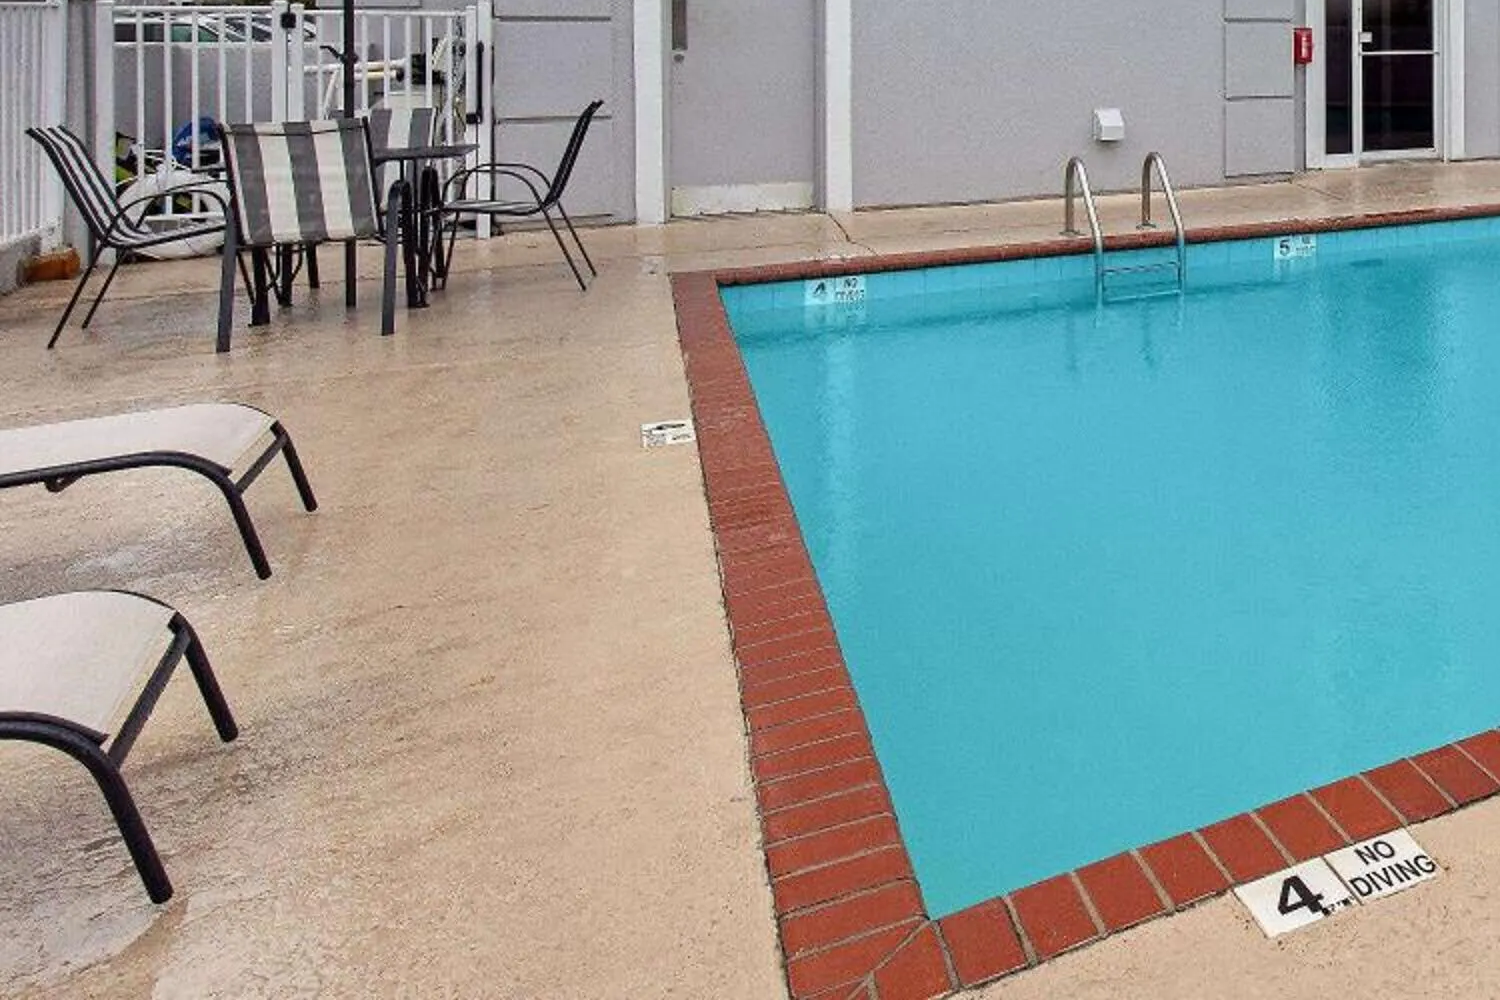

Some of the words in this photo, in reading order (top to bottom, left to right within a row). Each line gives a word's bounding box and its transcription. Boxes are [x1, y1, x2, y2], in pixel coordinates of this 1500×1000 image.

[1355, 840, 1396, 866] NO
[1277, 875, 1324, 915] 4
[1350, 854, 1436, 897] DIVING
